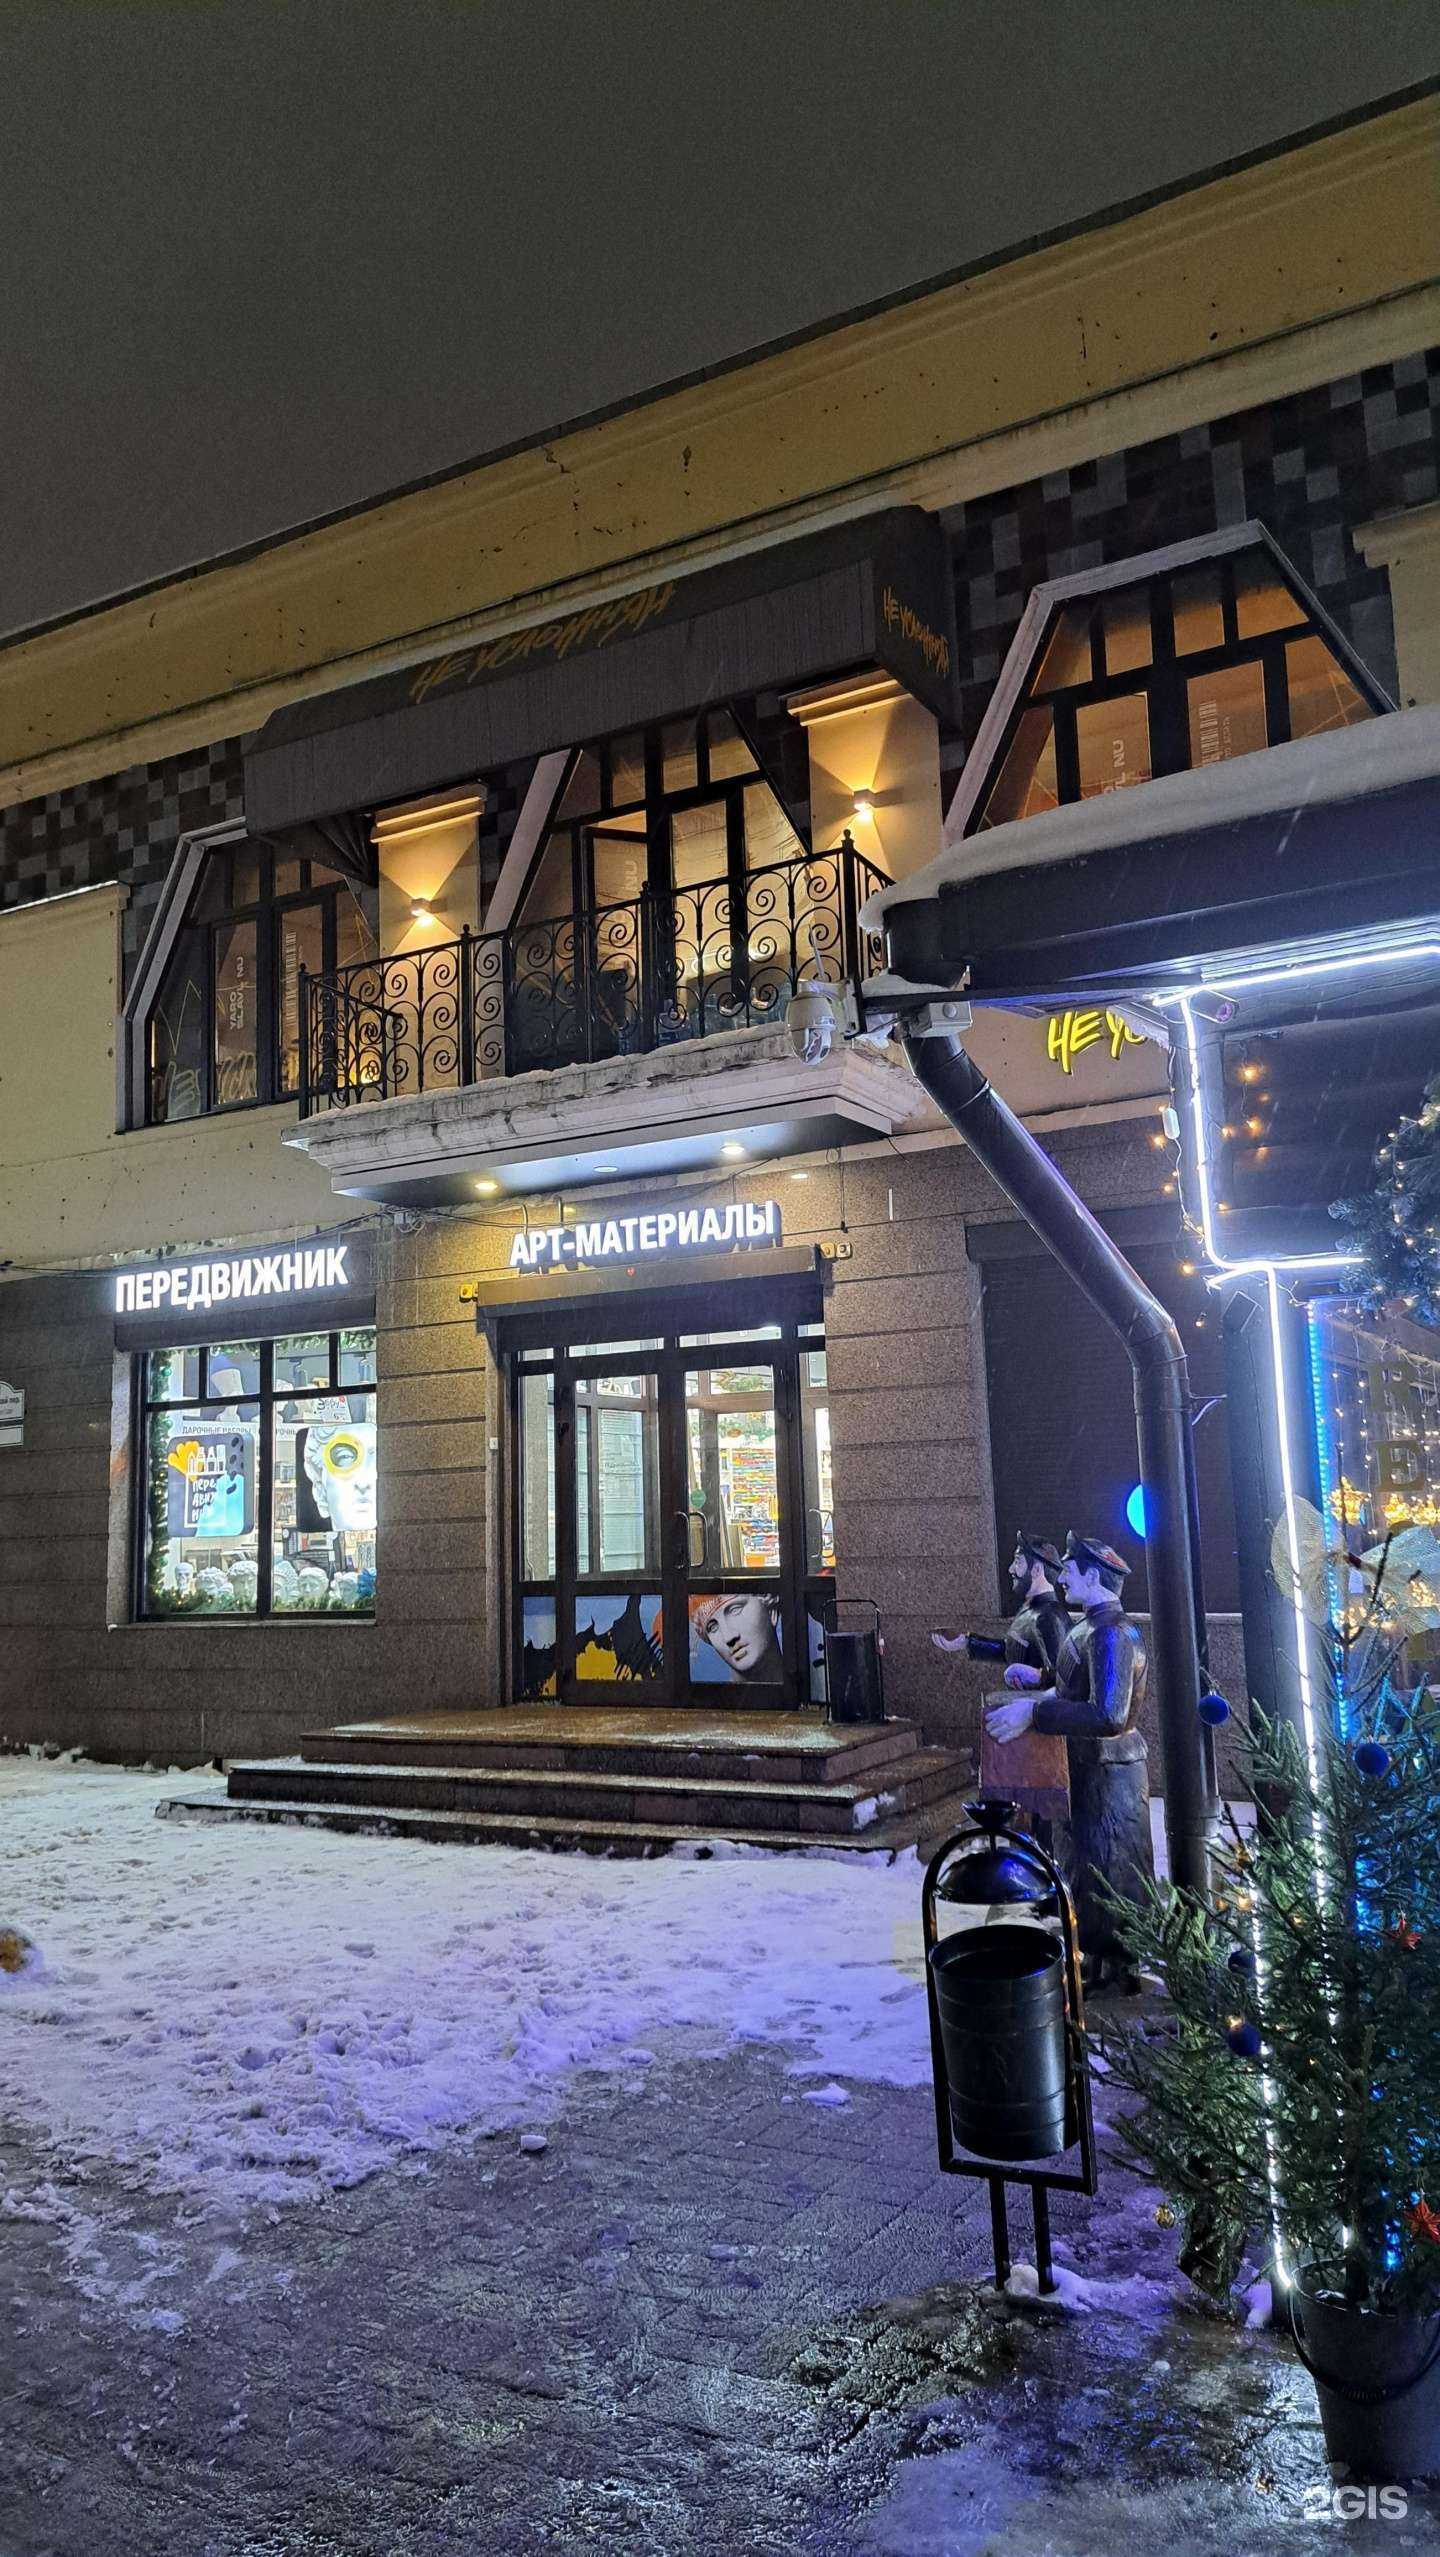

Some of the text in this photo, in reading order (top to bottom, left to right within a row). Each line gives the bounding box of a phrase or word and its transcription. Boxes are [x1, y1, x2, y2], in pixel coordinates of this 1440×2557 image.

[1048, 1011, 1101, 1073] НЕ
[509, 1200, 775, 1266] АРТ-МАТЕРИАЛЫ
[115, 1246, 349, 1312] ПЕРЕДВИЖНИК
